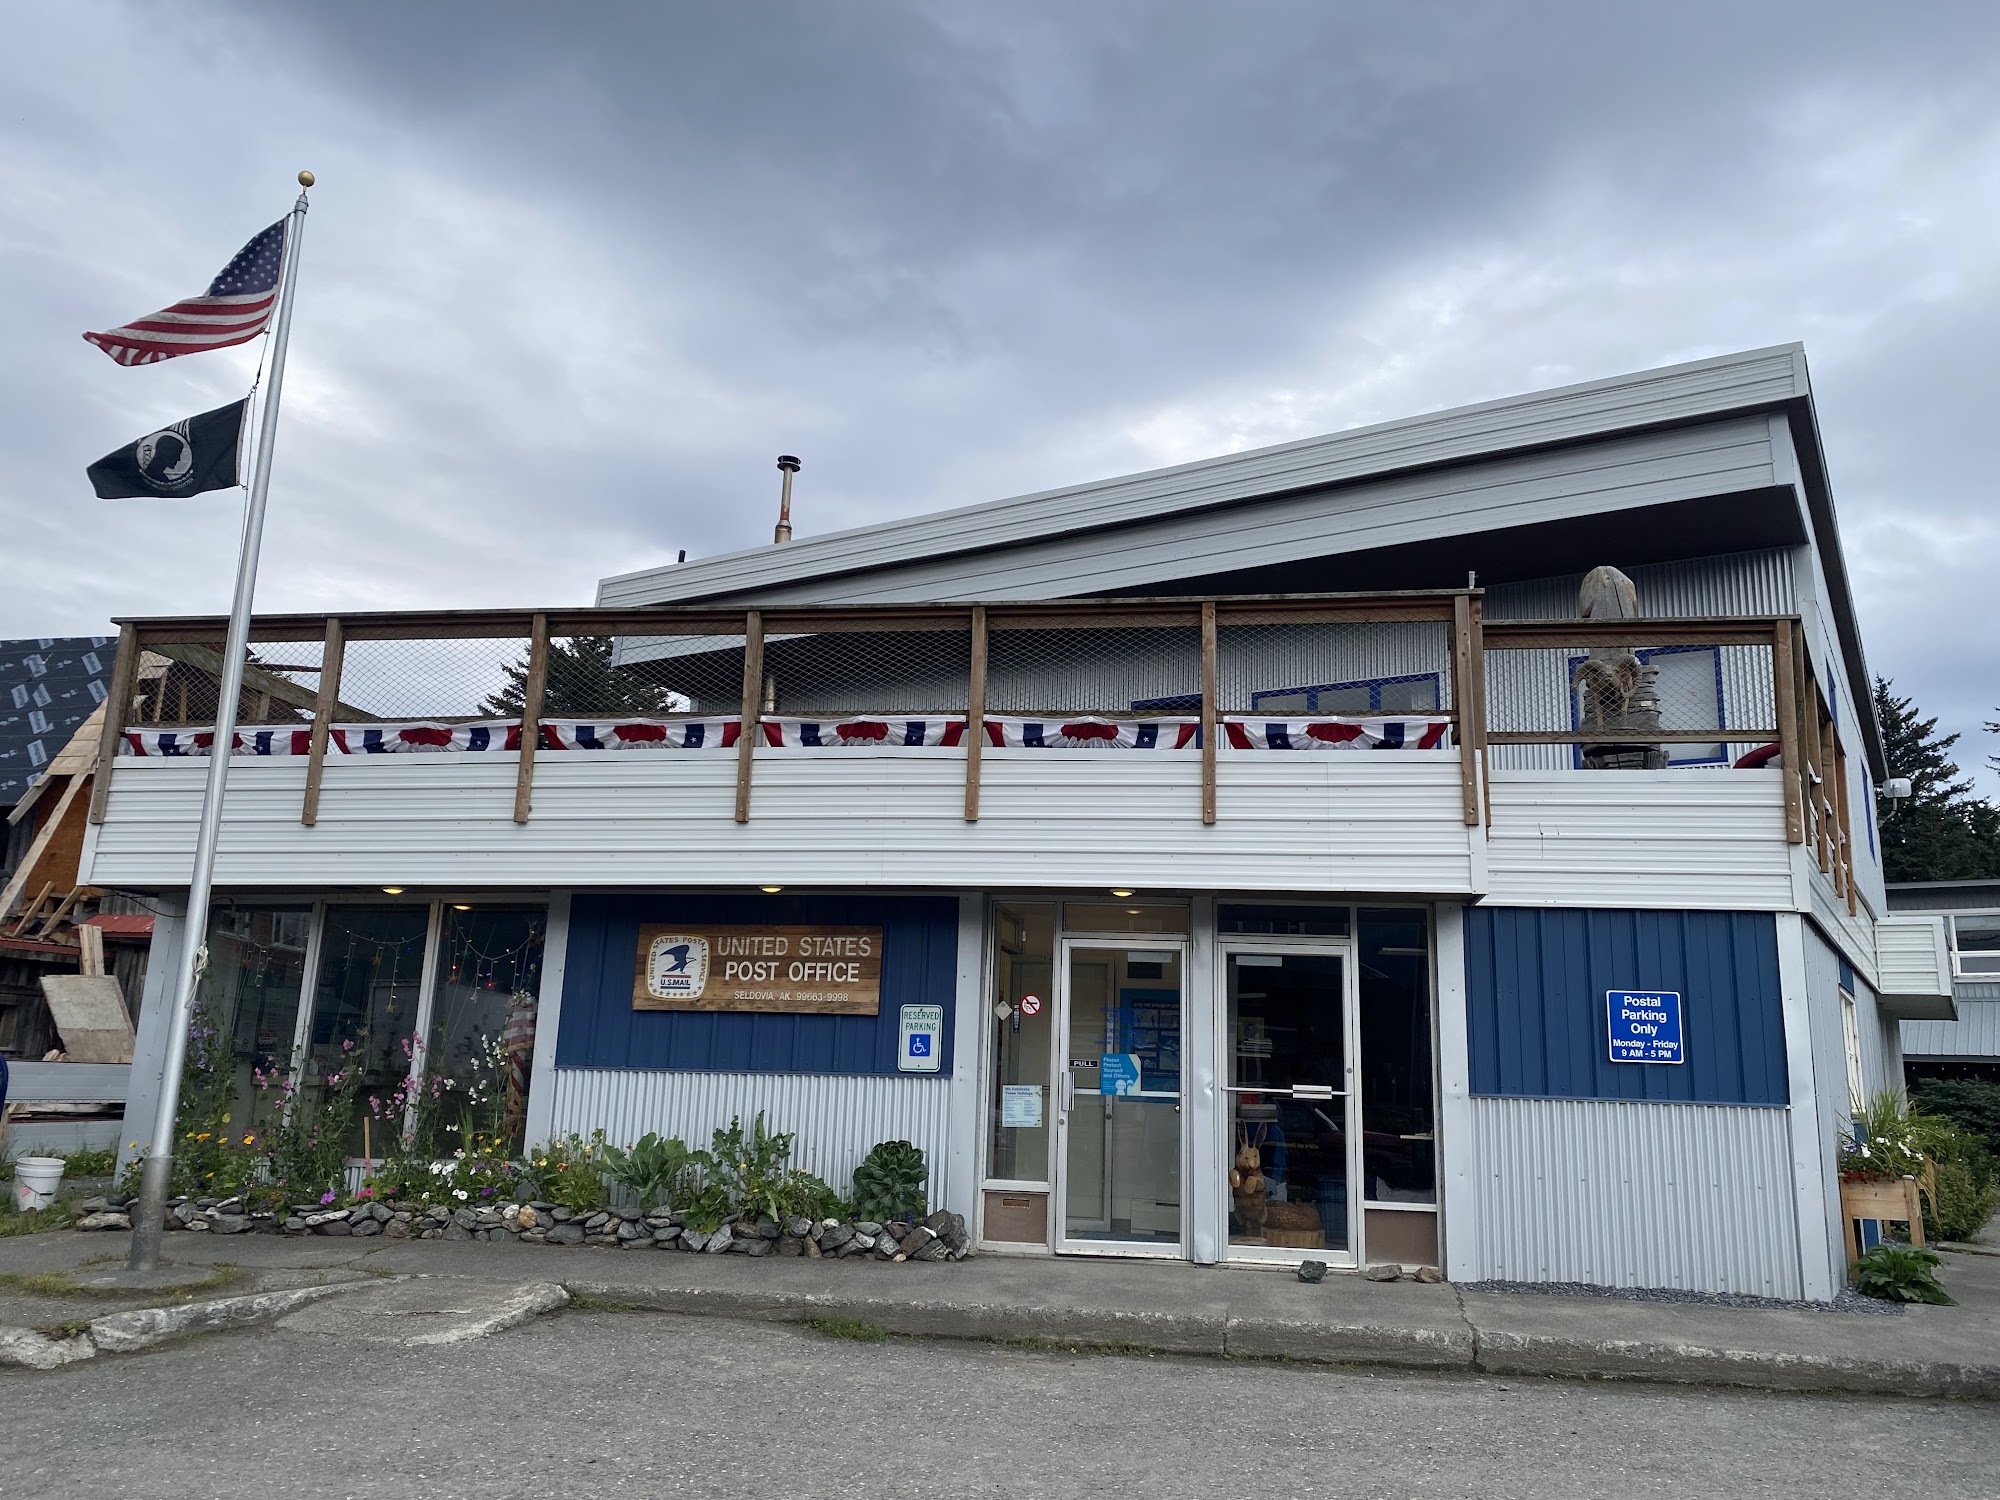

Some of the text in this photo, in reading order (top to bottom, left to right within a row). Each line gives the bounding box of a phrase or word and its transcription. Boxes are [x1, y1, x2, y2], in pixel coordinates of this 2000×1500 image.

[717, 936, 872, 957] UNITED STATES
[653, 937, 679, 949] STATES
[682, 937, 707, 952] POSTAL
[698, 954, 708, 982] SERVICE
[725, 961, 860, 982] POST OFFICE
[734, 991, 776, 1000] SELDOVIA,
[796, 992, 849, 1002] 99663-9998
[1624, 996, 1661, 1006] Postal
[904, 1011, 939, 1020] RESERVED
[1621, 1009, 1667, 1023] Parking
[905, 1023, 937, 1031] PARKING
[1630, 1023, 1658, 1036] Only
[1613, 1039, 1645, 1049] Monday
[1653, 1040, 1678, 1050] Friday
